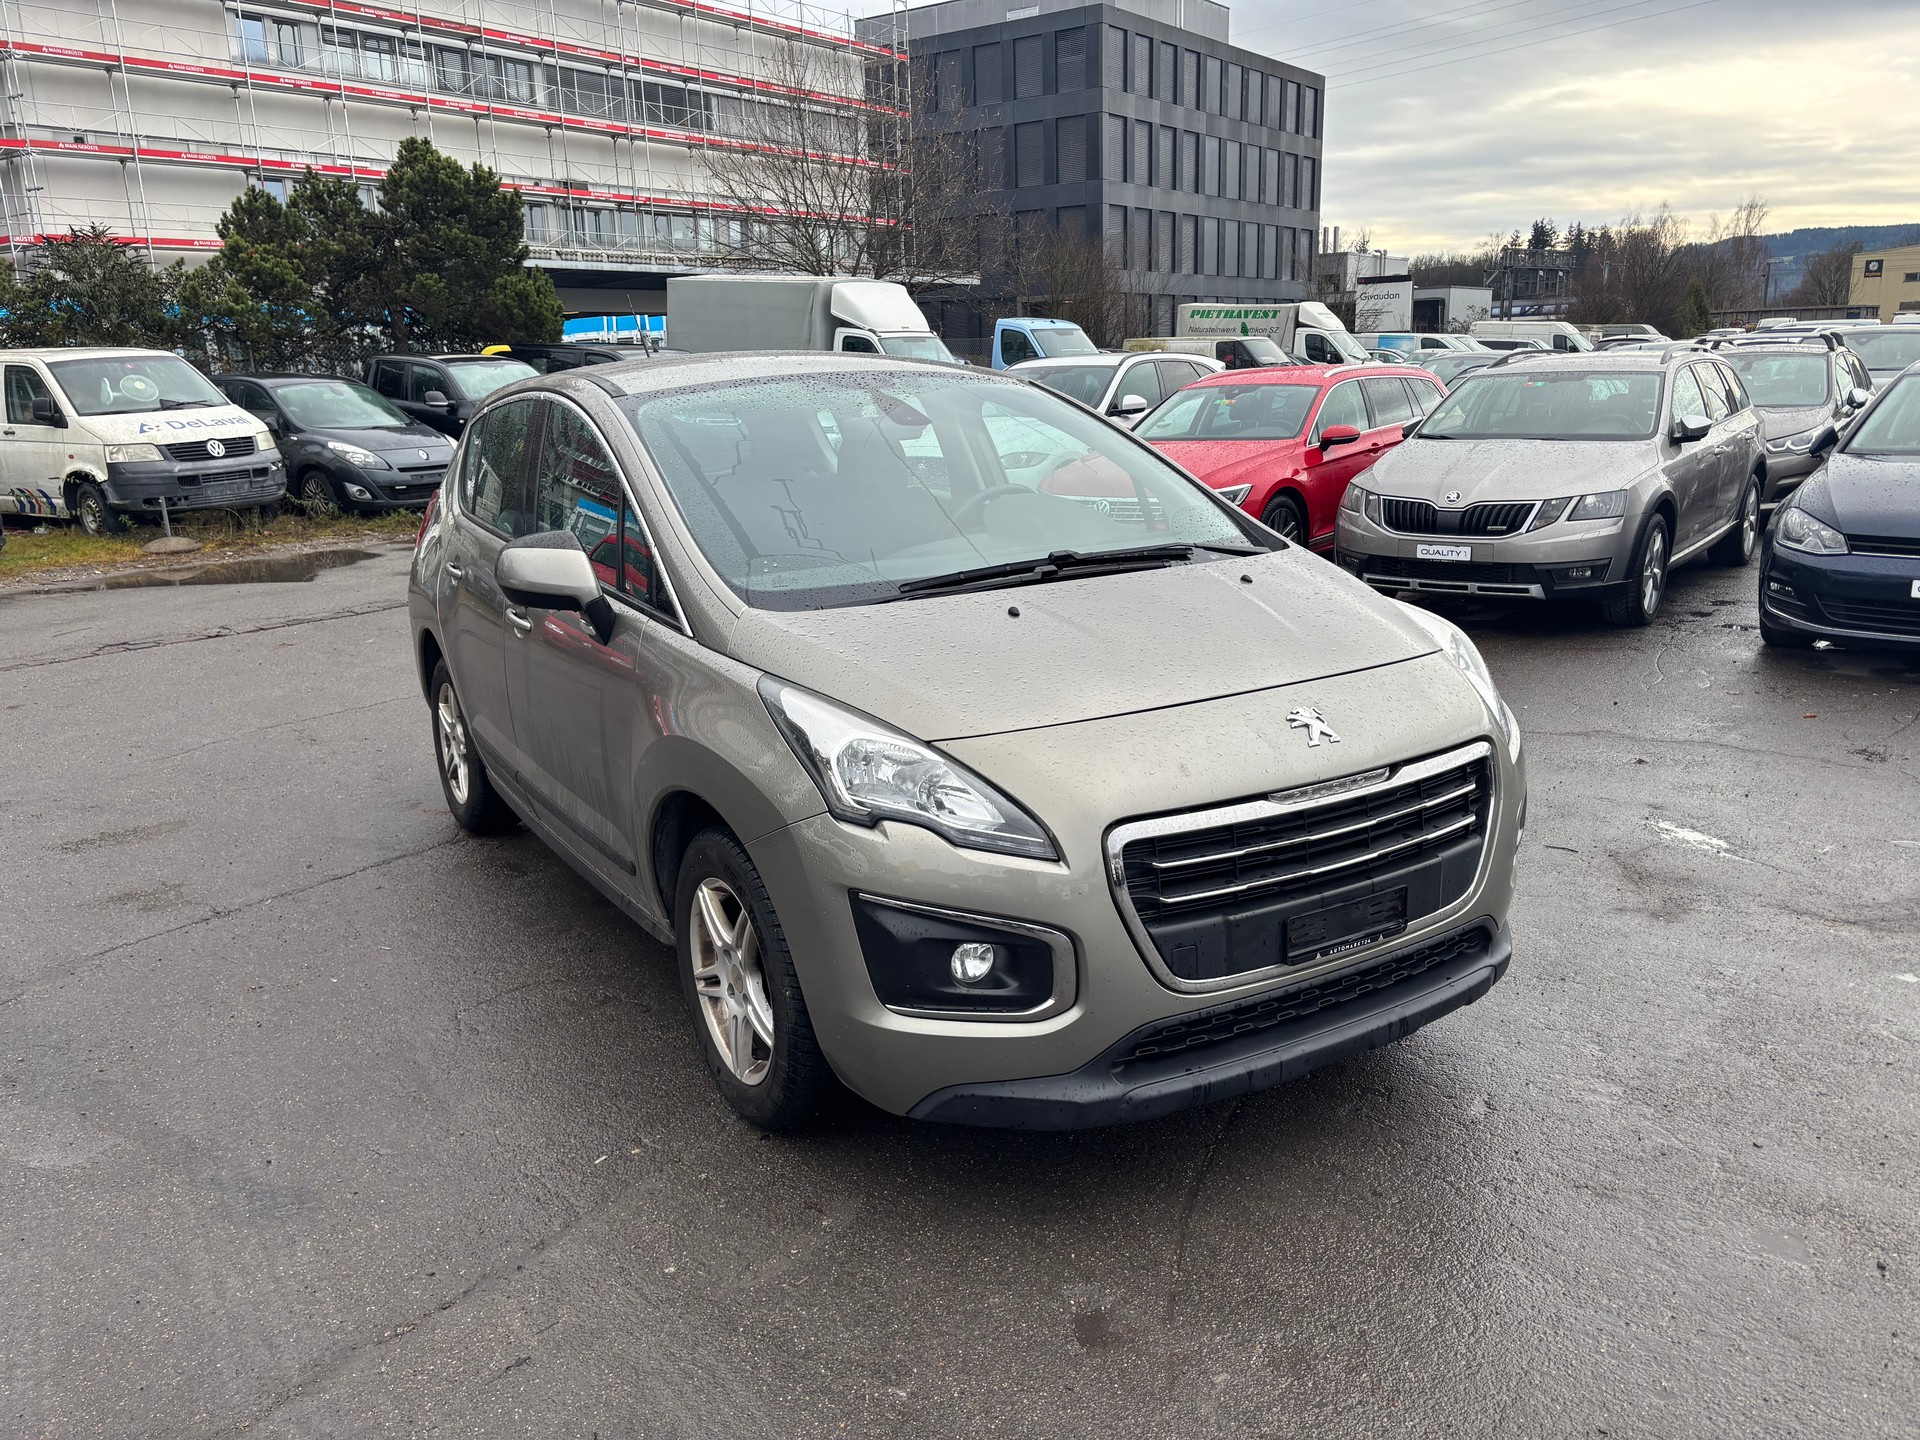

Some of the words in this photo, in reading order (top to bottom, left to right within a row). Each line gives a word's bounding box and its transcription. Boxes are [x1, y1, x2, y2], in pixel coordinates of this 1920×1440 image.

[1360, 290, 1400, 301] Givaudan
[1190, 309, 1280, 320] PIETRAVEST
[1188, 326, 1237, 334] Natursteinwerk
[1269, 326, 1280, 334] SZ
[165, 416, 253, 430] DeLaval
[1420, 548, 1462, 558] QUALITY
[1329, 939, 1371, 954] AUTOMARKT24
